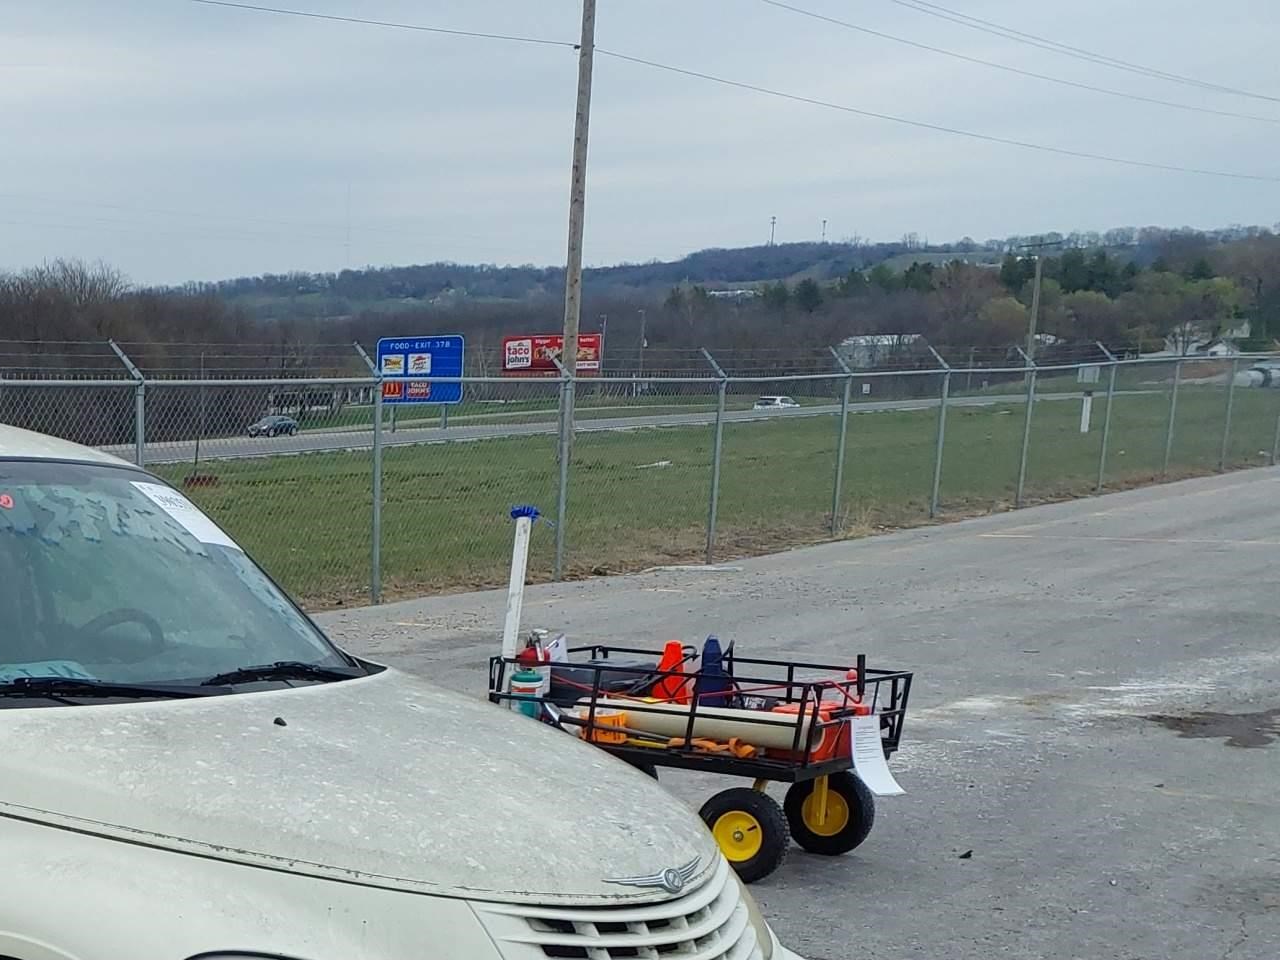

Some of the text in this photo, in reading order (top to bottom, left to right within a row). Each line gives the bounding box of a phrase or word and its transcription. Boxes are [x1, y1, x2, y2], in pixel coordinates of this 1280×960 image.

[390, 342, 410, 350] FOOD
[415, 341, 432, 349] EXIT
[507, 346, 530, 355] taco
[507, 355, 530, 365] john's
